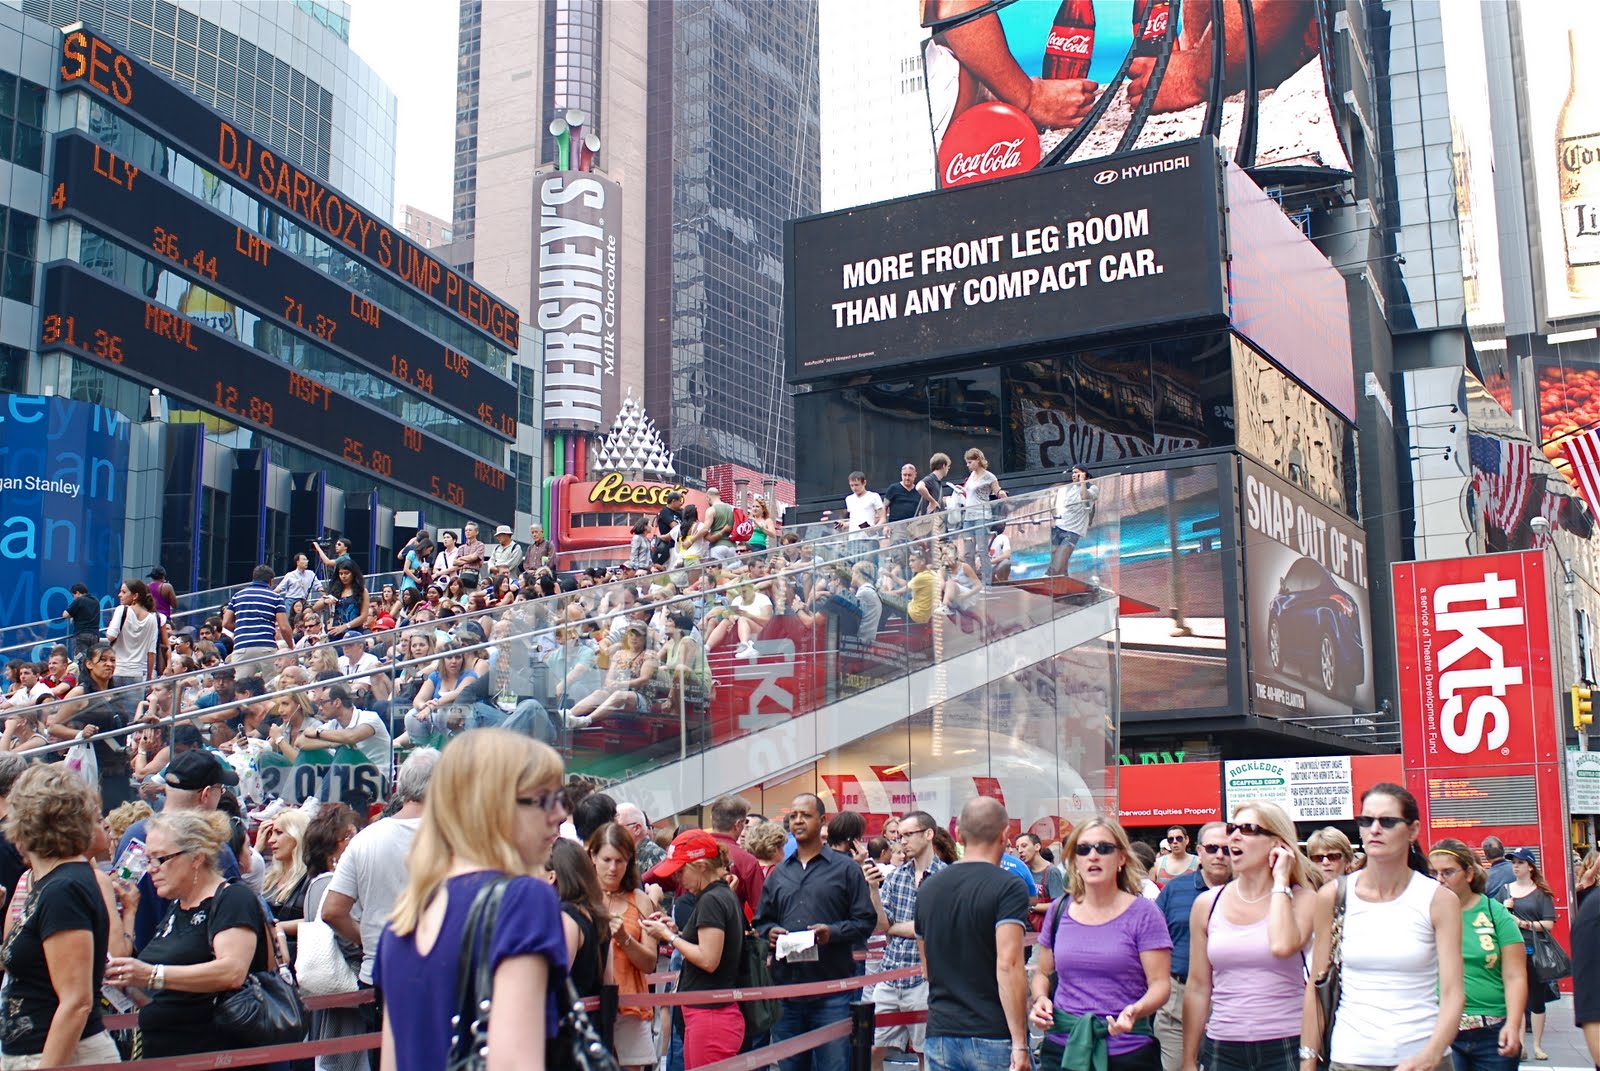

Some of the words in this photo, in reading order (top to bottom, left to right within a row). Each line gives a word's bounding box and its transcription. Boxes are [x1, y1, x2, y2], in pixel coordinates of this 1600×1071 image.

[1046, 32, 1090, 54] Coca-Cola
[61, 32, 132, 105] SES
[218, 121, 252, 180] DJ
[258, 150, 392, 268] SARKOZY'S
[398, 239, 440, 296] UMP
[945, 138, 1025, 184] Coca-Cola
[1121, 156, 1190, 181] HYUNDAI
[93, 144, 138, 191] LLY
[235, 226, 272, 266] LMT
[350, 293, 381, 329] LOW
[842, 252, 914, 290] MORE
[921, 235, 1004, 276] FRONT
[1011, 225, 1060, 259] LEG
[1066, 208, 1150, 250] ROOM
[538, 177, 605, 423] HERSHEY'S
[605, 234, 617, 328] Chocolate
[831, 293, 897, 329] THAN
[903, 282, 958, 317] ANY
[962, 259, 1092, 307] COMPACT
[1098, 248, 1164, 283] CAR.
[153, 225, 218, 283] 36.44
[284, 295, 337, 342] 71.37
[391, 354, 433, 394] 18.94
[477, 402, 516, 438] 45.10
[605, 330, 615, 376] Milk
[144, 303, 200, 351] MRVL
[288, 371, 332, 411] MSFT
[42, 313, 124, 364] 31.36
[214, 381, 274, 427] 12.89
[343, 437, 392, 476] 25.80
[431, 475, 465, 507] 5.50
[25, 475, 80, 498] Stanley
[589, 471, 688, 505] Reese's
[1246, 475, 1294, 546] SNAP
[1296, 505, 1327, 567] OUT
[1330, 526, 1348, 577] OF
[1351, 538, 1368, 589] IT.
[1420, 596, 1429, 626] service
[1422, 628, 1430, 637] of
[1423, 638, 1432, 672] Theatre
[1433, 572, 1524, 754] tkts
[1255, 682, 1267, 699] THE
[1425, 674, 1436, 731] Development
[1429, 732, 1438, 754] Fund
[1229, 762, 1284, 777] ROCKLEDGE
[1152, 808, 1183, 816] Equities
[1184, 807, 1217, 815] Property
